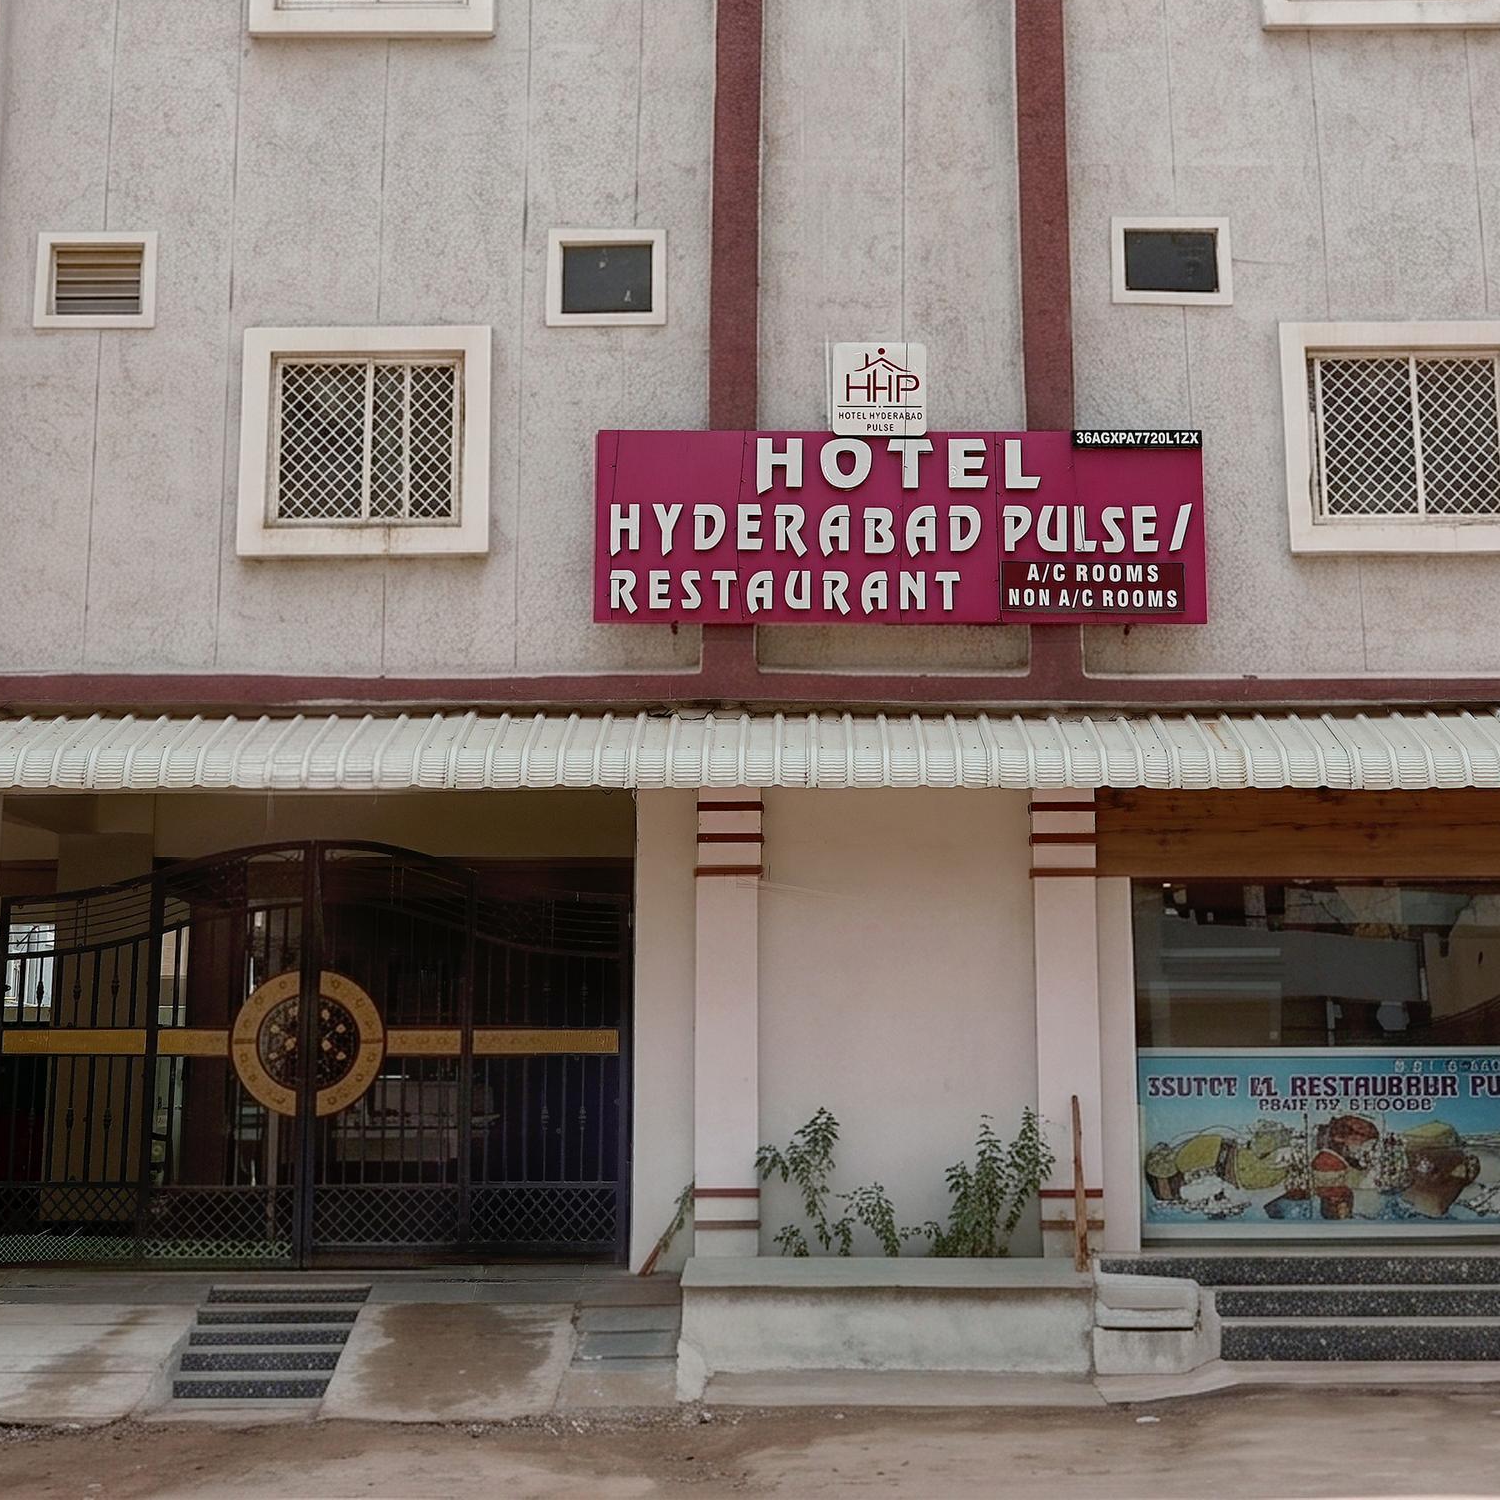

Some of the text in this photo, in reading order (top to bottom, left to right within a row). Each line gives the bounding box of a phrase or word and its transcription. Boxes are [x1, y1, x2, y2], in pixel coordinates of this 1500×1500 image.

[845, 368, 920, 403] HHP
[838, 411, 923, 421] HOTEL HYDERABAD
[866, 423, 895, 432] PULSE
[1075, 431, 1199, 445] 36AGXPA7720L1ZX
[755, 437, 1042, 495] HOTEL
[609, 503, 982, 557] HYDERABAD
[1026, 563, 1160, 583] A/C ROOMS
[608, 569, 961, 615] RESTAURANT
[1008, 588, 1178, 608] NON A/C ROOMS
